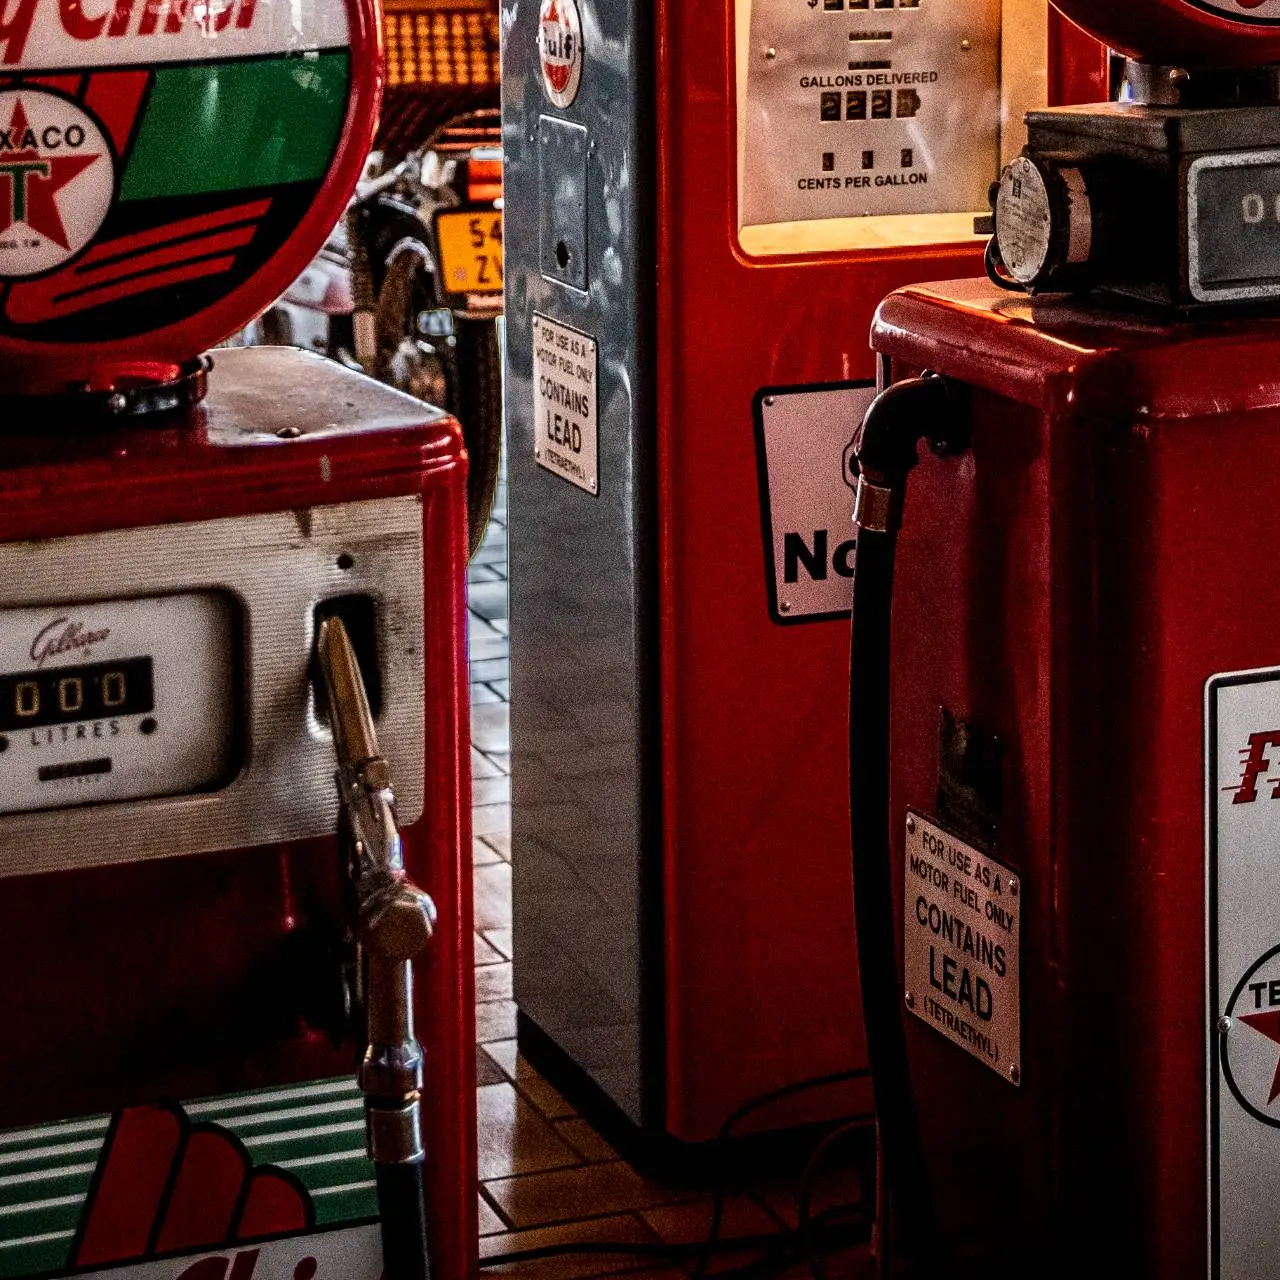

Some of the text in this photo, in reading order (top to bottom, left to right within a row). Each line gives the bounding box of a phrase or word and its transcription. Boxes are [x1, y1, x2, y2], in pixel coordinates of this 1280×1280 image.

[800, 71, 938, 88] GALLONS DELIVERED
[797, 173, 927, 190] CENTS PER GALLON
[541, 327, 554, 342] FOR
[556, 332, 569, 351] USE
[571, 341, 580, 356] AS
[559, 357, 575, 376] FUEL
[576, 365, 593, 384] ONLY
[540, 376, 588, 418] CONTAINS
[547, 409, 581, 453] LEAD
[31, 720, 120, 746] LITRES
[923, 830, 1002, 896] FOR USE AS A
[910, 854, 1013, 933] MOTOR FUEL ONLY
[916, 896, 1006, 977] CONTAINS
[930, 945, 993, 1021] LEAD
[924, 996, 999, 1062] (TETRAETHYL)
